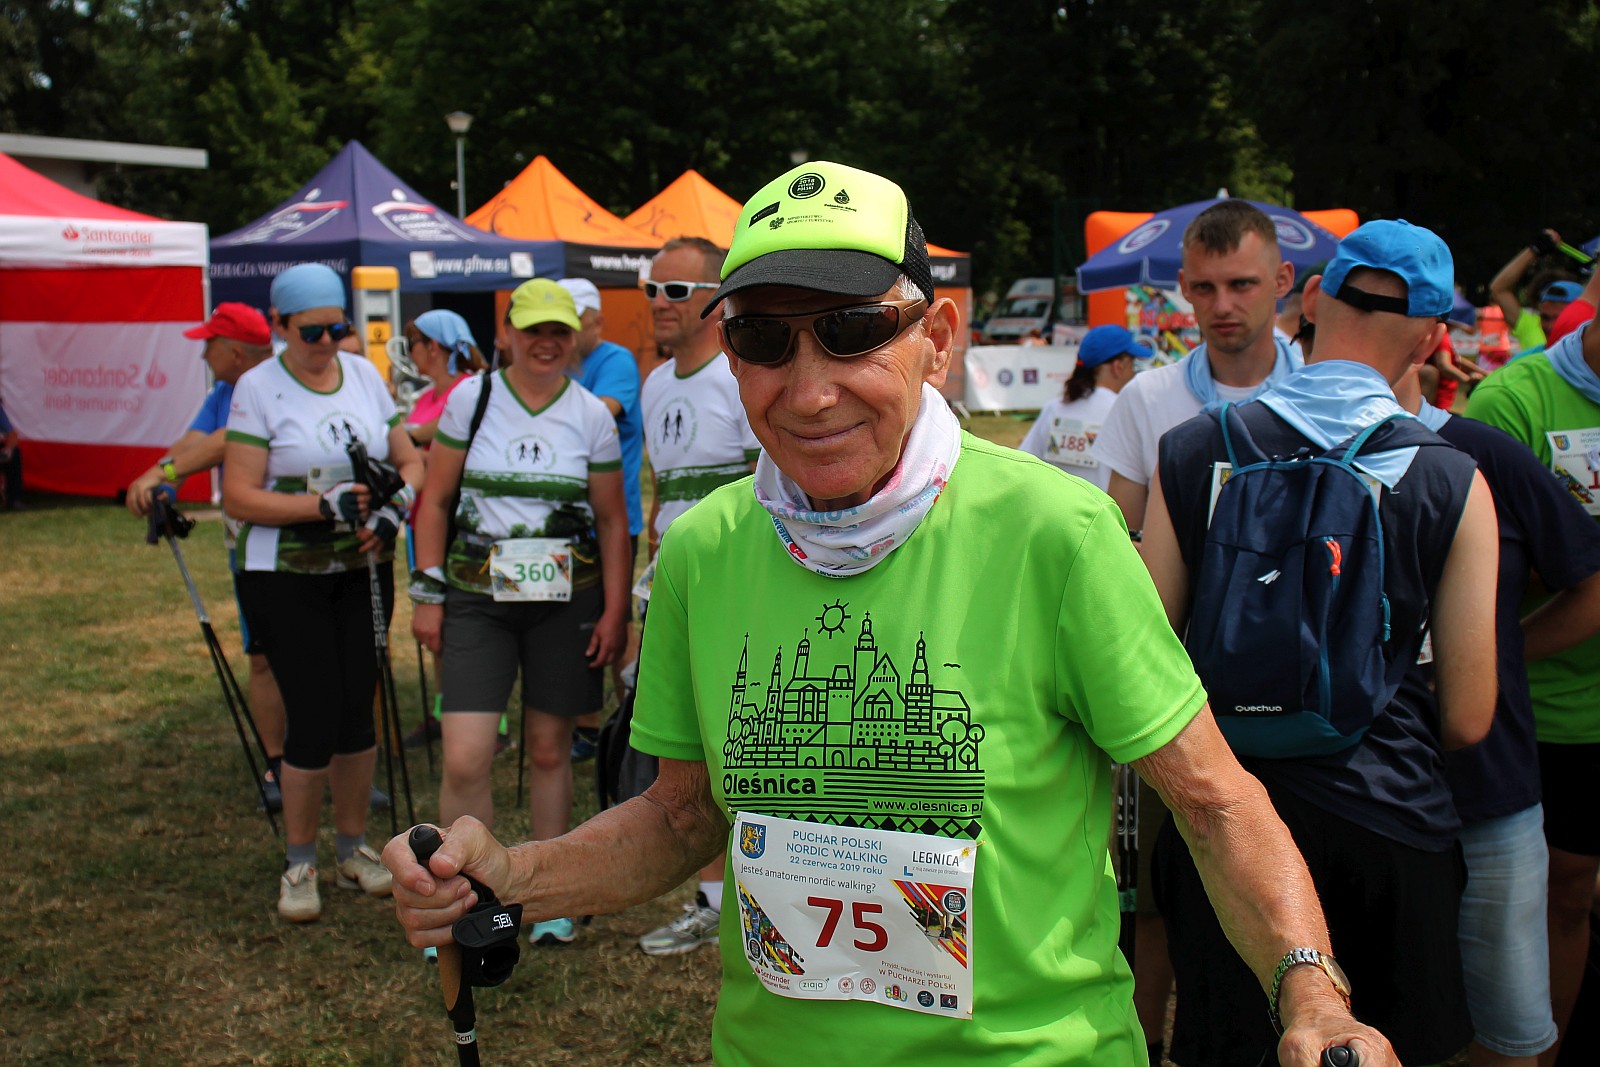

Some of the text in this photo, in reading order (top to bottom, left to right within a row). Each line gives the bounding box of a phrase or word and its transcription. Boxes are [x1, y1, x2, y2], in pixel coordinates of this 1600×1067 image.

[82, 227, 152, 243] Santander
[435, 255, 509, 277] www.pfnw.eu
[1060, 435, 1086, 452] 188
[513, 563, 555, 583] 360
[1235, 705, 1283, 713] Quechua
[722, 772, 817, 796] Oleśnica
[872, 801, 984, 813] www.olesnica.pl
[793, 830, 882, 851] PUCHAR POLSKI
[786, 842, 888, 865] NORDIC WALKING
[912, 850, 959, 867] LEGNICA
[790, 855, 883, 875] 22 czerwca 2019 roku
[740, 863, 876, 894] Jesteś amatorem nordic walking?
[807, 895, 889, 953] 75
[761, 969, 790, 985] Santander
[802, 982, 823, 990] ziaja
[888, 970, 925, 986] PUCHARZE
[928, 979, 956, 990] POLSKI
